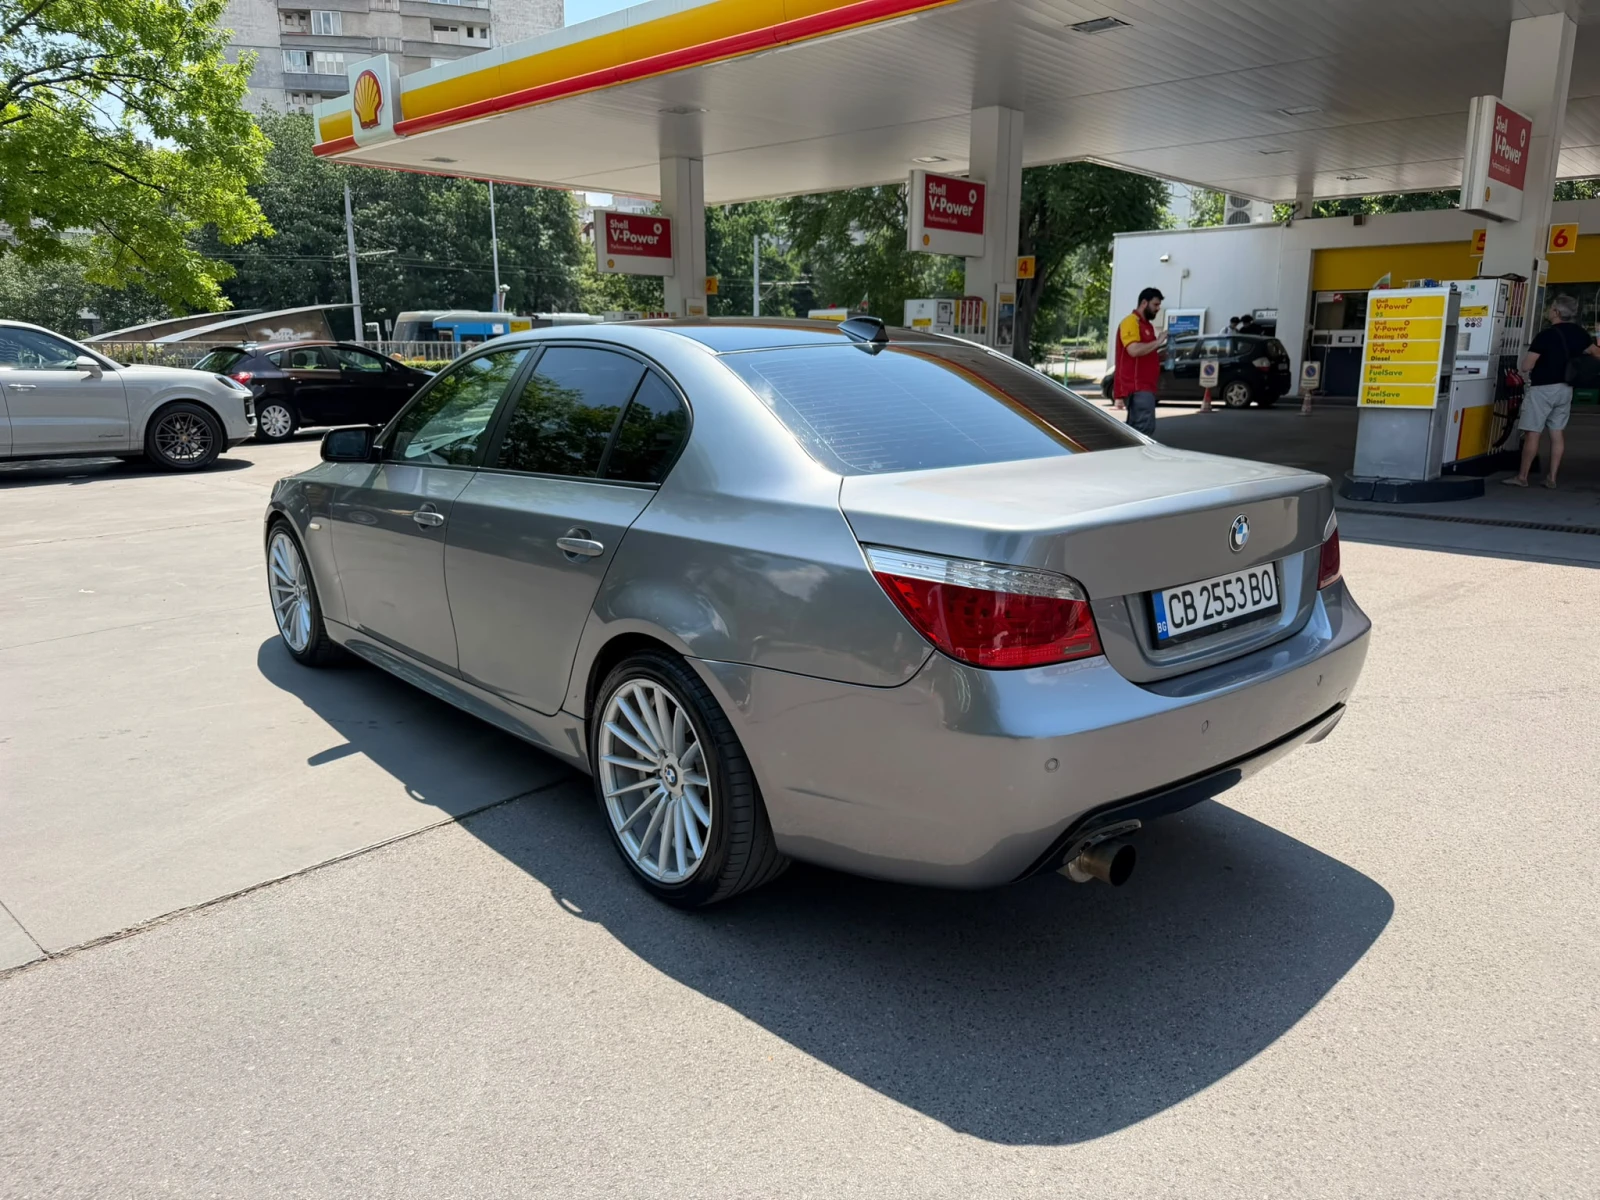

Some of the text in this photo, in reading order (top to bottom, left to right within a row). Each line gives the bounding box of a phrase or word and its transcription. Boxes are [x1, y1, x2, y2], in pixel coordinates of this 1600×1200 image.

[1496, 115, 1508, 134] Shell
[1494, 132, 1521, 164] V-Power
[928, 182, 946, 196] Shell
[928, 195, 973, 217] V-Power
[610, 219, 629, 229] Shell
[610, 229, 659, 245] V-Power
[1476, 233, 1486, 251] 5
[1553, 228, 1568, 247] 6
[1019, 260, 1029, 274] 4
[706, 280, 712, 291] 2
[1367, 390, 1400, 398] FuelSave
[1168, 590, 1198, 629] CB
[1199, 577, 1248, 621] 2553
[1157, 621, 1167, 633] BG
